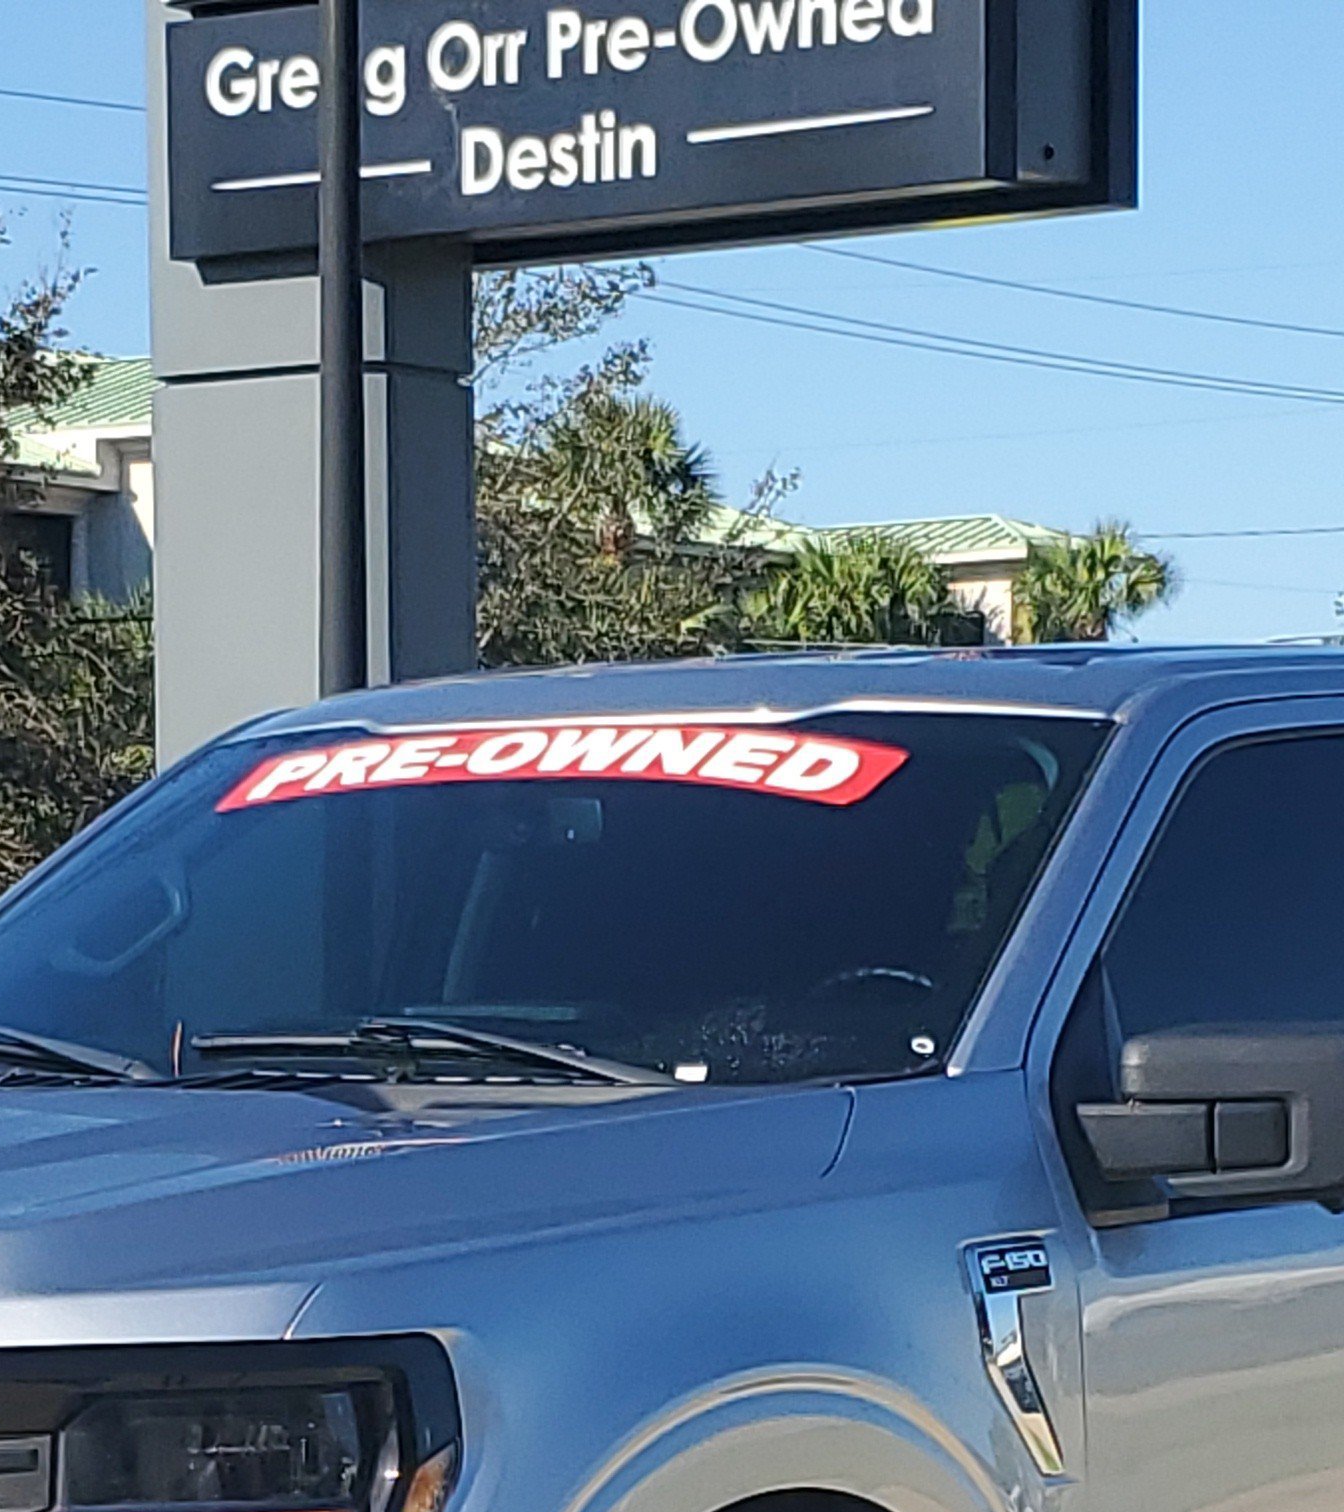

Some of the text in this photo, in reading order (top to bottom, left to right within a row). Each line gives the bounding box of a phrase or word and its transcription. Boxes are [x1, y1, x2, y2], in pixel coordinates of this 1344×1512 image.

[206, 45, 405, 116] Greg
[427, 20, 527, 92] Orr
[461, 108, 656, 196] Destin
[246, 727, 859, 802] PRE-OWNED
[980, 1249, 1048, 1275] F-150
